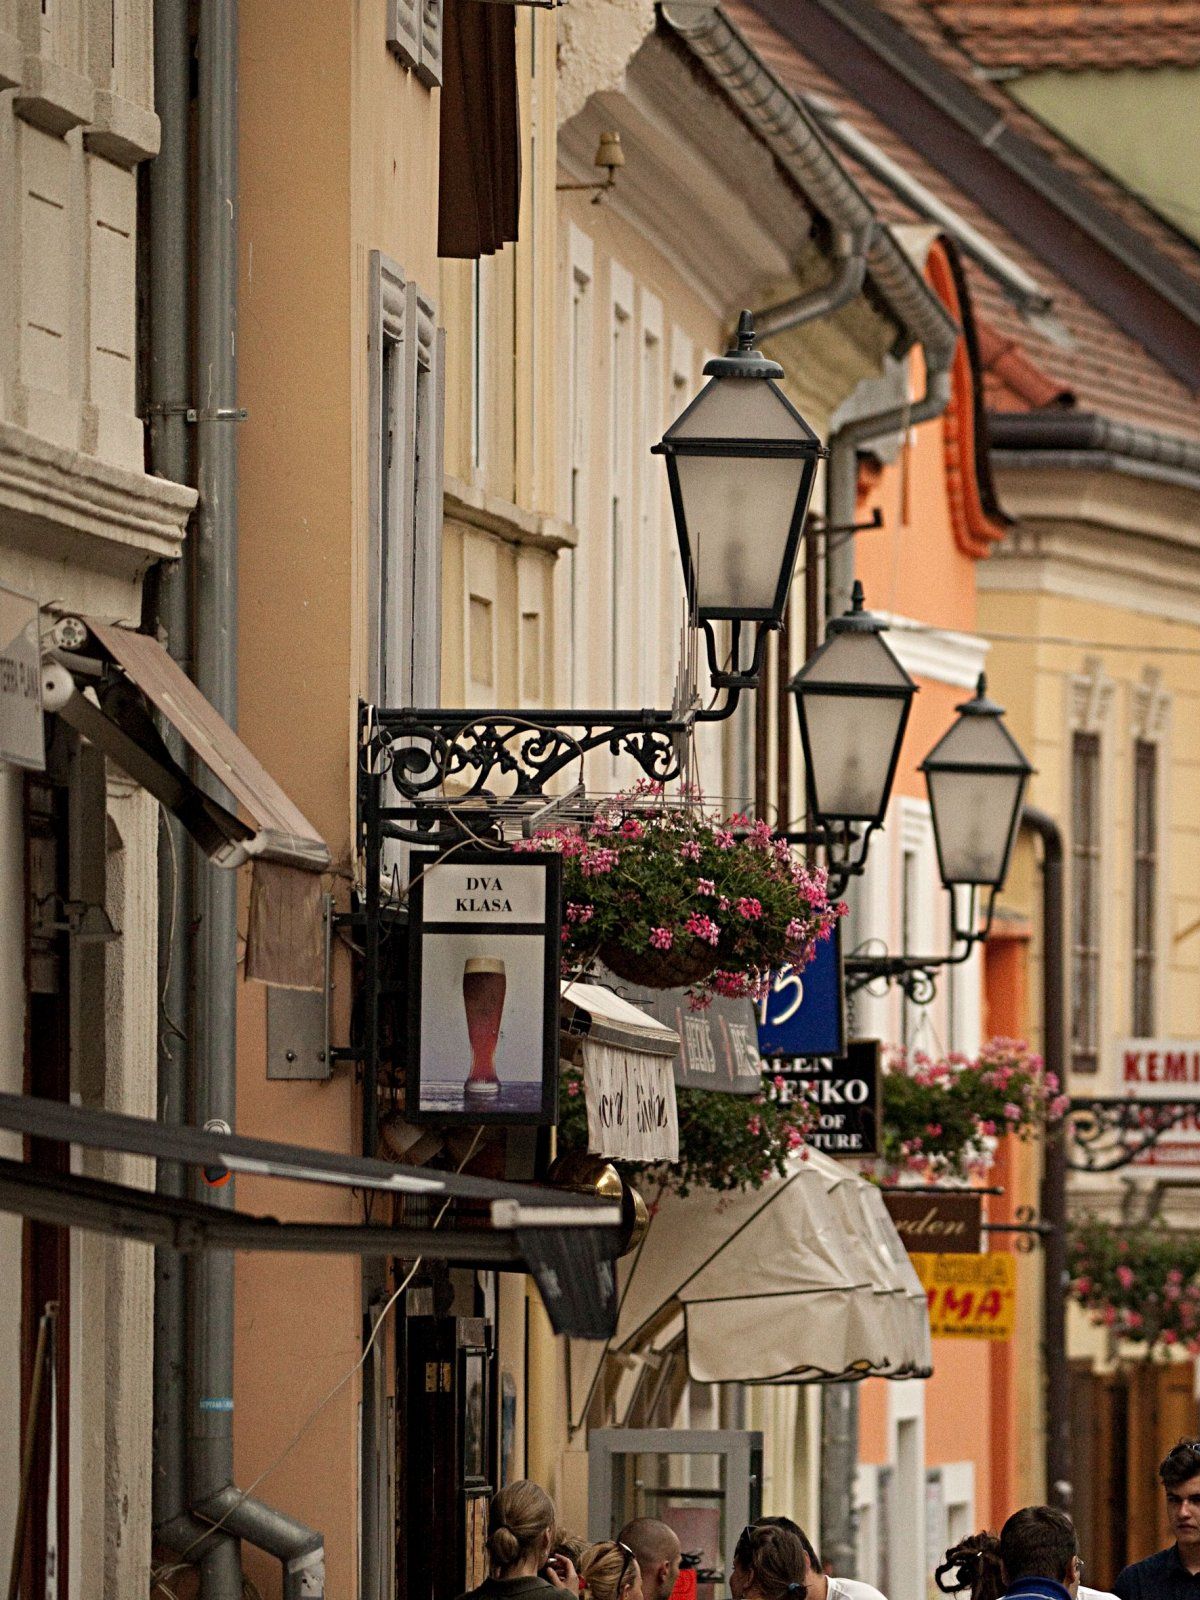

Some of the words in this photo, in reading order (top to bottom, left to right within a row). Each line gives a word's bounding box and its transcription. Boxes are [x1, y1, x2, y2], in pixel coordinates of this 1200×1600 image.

[466, 877, 503, 890] DVA
[456, 898, 512, 912] KLASA
[819, 1114, 847, 1130] OF
[804, 1133, 863, 1149] TURE
